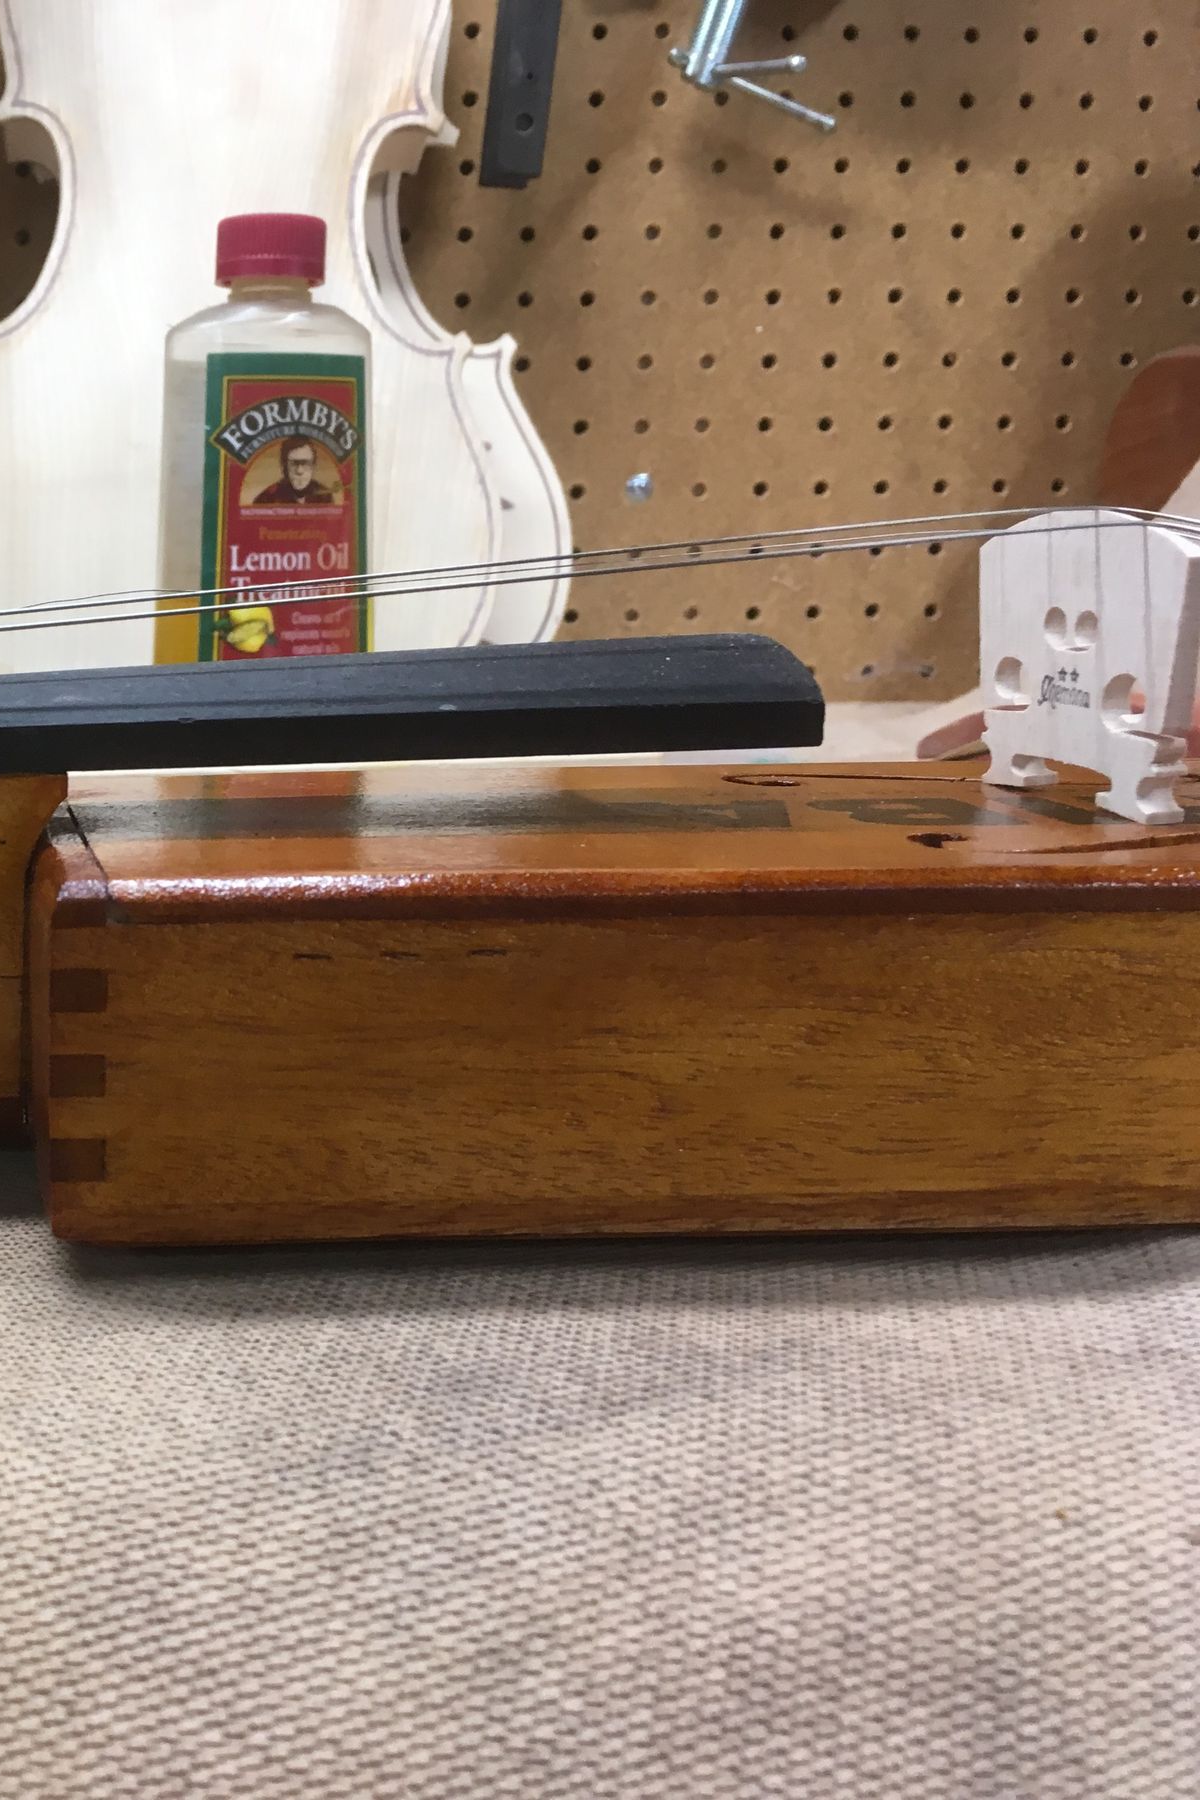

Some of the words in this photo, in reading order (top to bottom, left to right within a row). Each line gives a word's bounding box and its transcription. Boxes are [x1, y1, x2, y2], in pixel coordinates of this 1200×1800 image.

[221, 399, 358, 451] FORMBY'S
[230, 544, 311, 572] Lemon
[317, 543, 349, 571] Oil
